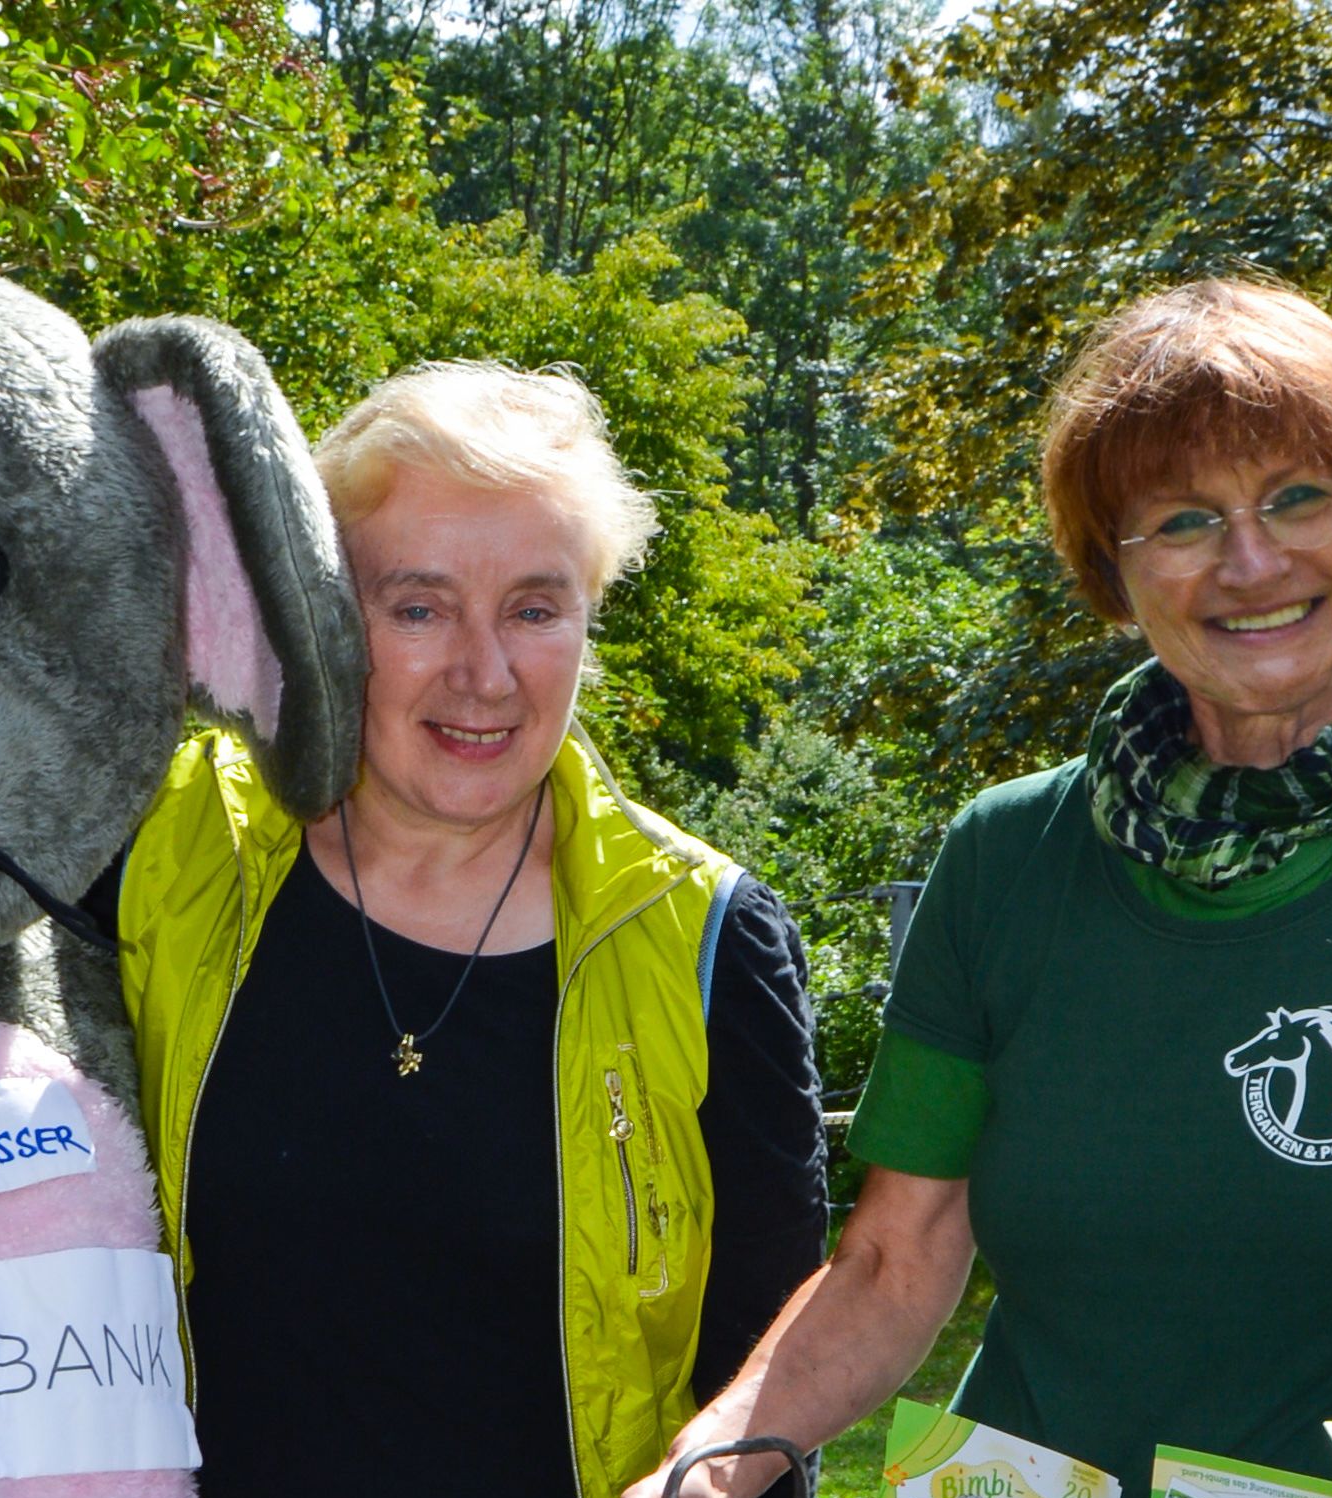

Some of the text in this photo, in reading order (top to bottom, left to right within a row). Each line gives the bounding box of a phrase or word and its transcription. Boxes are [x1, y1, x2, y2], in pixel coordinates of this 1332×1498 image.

[1248, 1076, 1304, 1156] TIERGARTEN
[1303, 1145, 1318, 1159] &
[1231, 1479, 1248, 1490] das
